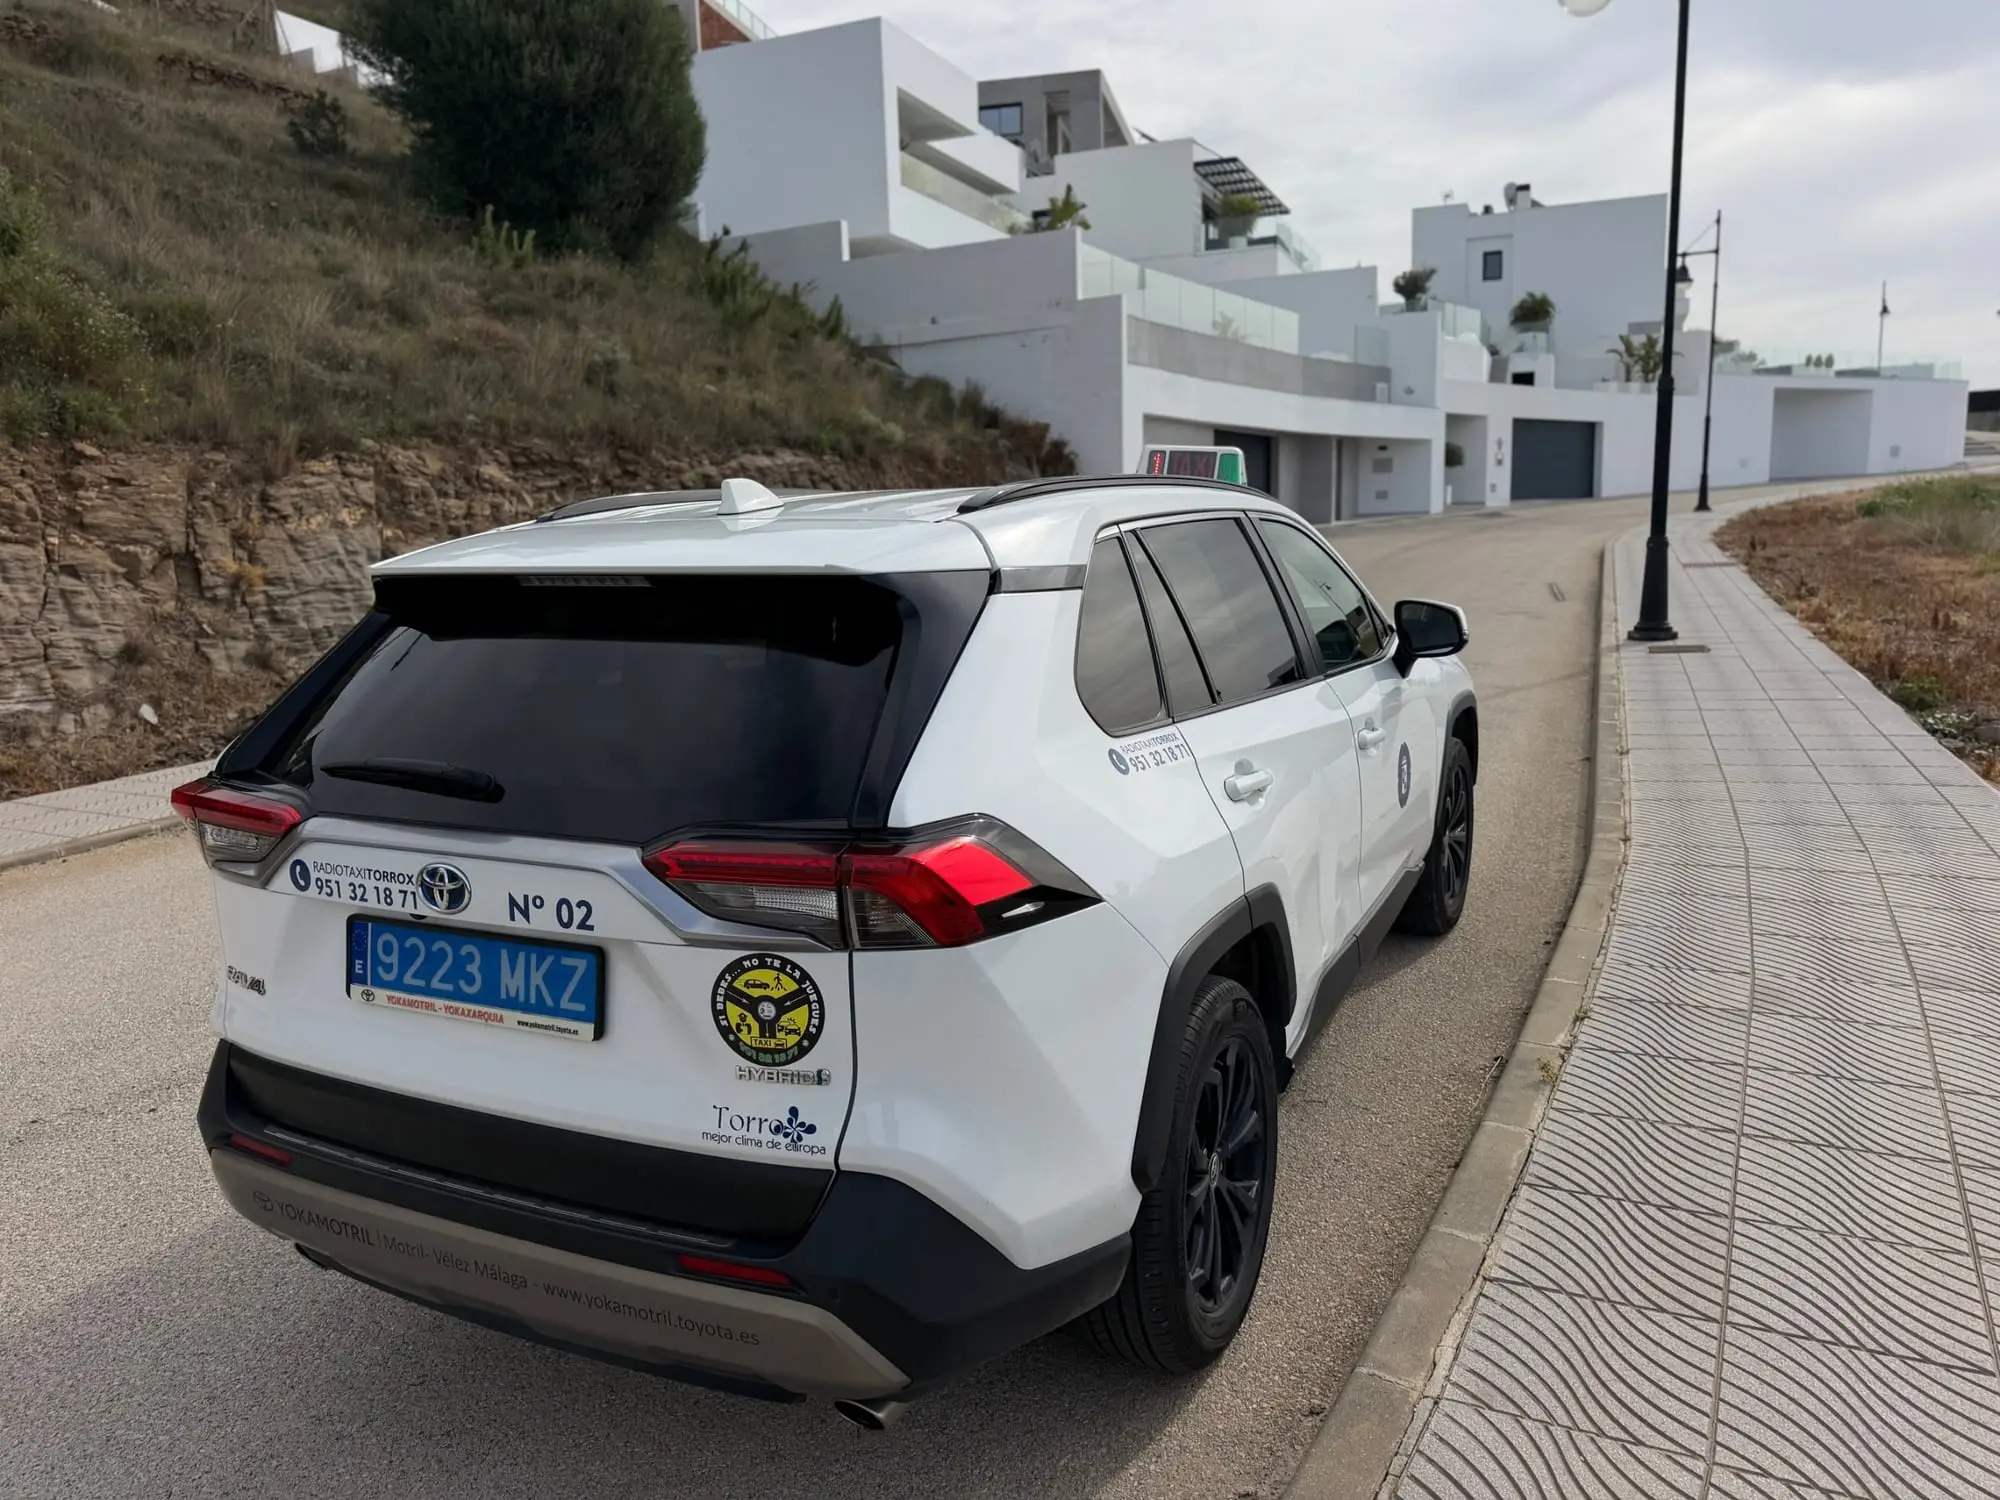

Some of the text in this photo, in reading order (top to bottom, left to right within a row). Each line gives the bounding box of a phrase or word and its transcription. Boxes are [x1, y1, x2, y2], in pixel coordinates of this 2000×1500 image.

[1170, 452, 1214, 477] TAXI
[1120, 732, 1181, 754] RADIOTAXITORROX
[1129, 743, 1190, 772] 951 32 18 71
[312, 861, 415, 886] RADIOTAXITORROX
[315, 876, 418, 910] 951 32 18 71
[556, 897, 595, 932] 02
[355, 959, 364, 974] E
[376, 932, 587, 1012] 9223 MKZ
[386, 994, 437, 1013] YOKAMOTRIL
[443, 1004, 505, 1024] YOKAXARQUIA
[718, 1015, 728, 1027] SI
[742, 958, 759, 969] NO
[765, 957, 781, 969] TE
[785, 964, 801, 979] LA
[801, 980, 819, 1034] JUEGUES
[754, 1039, 772, 1047] TAXI
[702, 1130, 826, 1155] mejor clima de europa
[278, 1202, 375, 1247] YOKAMOTRIL
[433, 1249, 470, 1273] Vélez
[474, 1259, 528, 1290] Málaga
[542, 1281, 760, 1346] www.yokamotril.toyota.es
